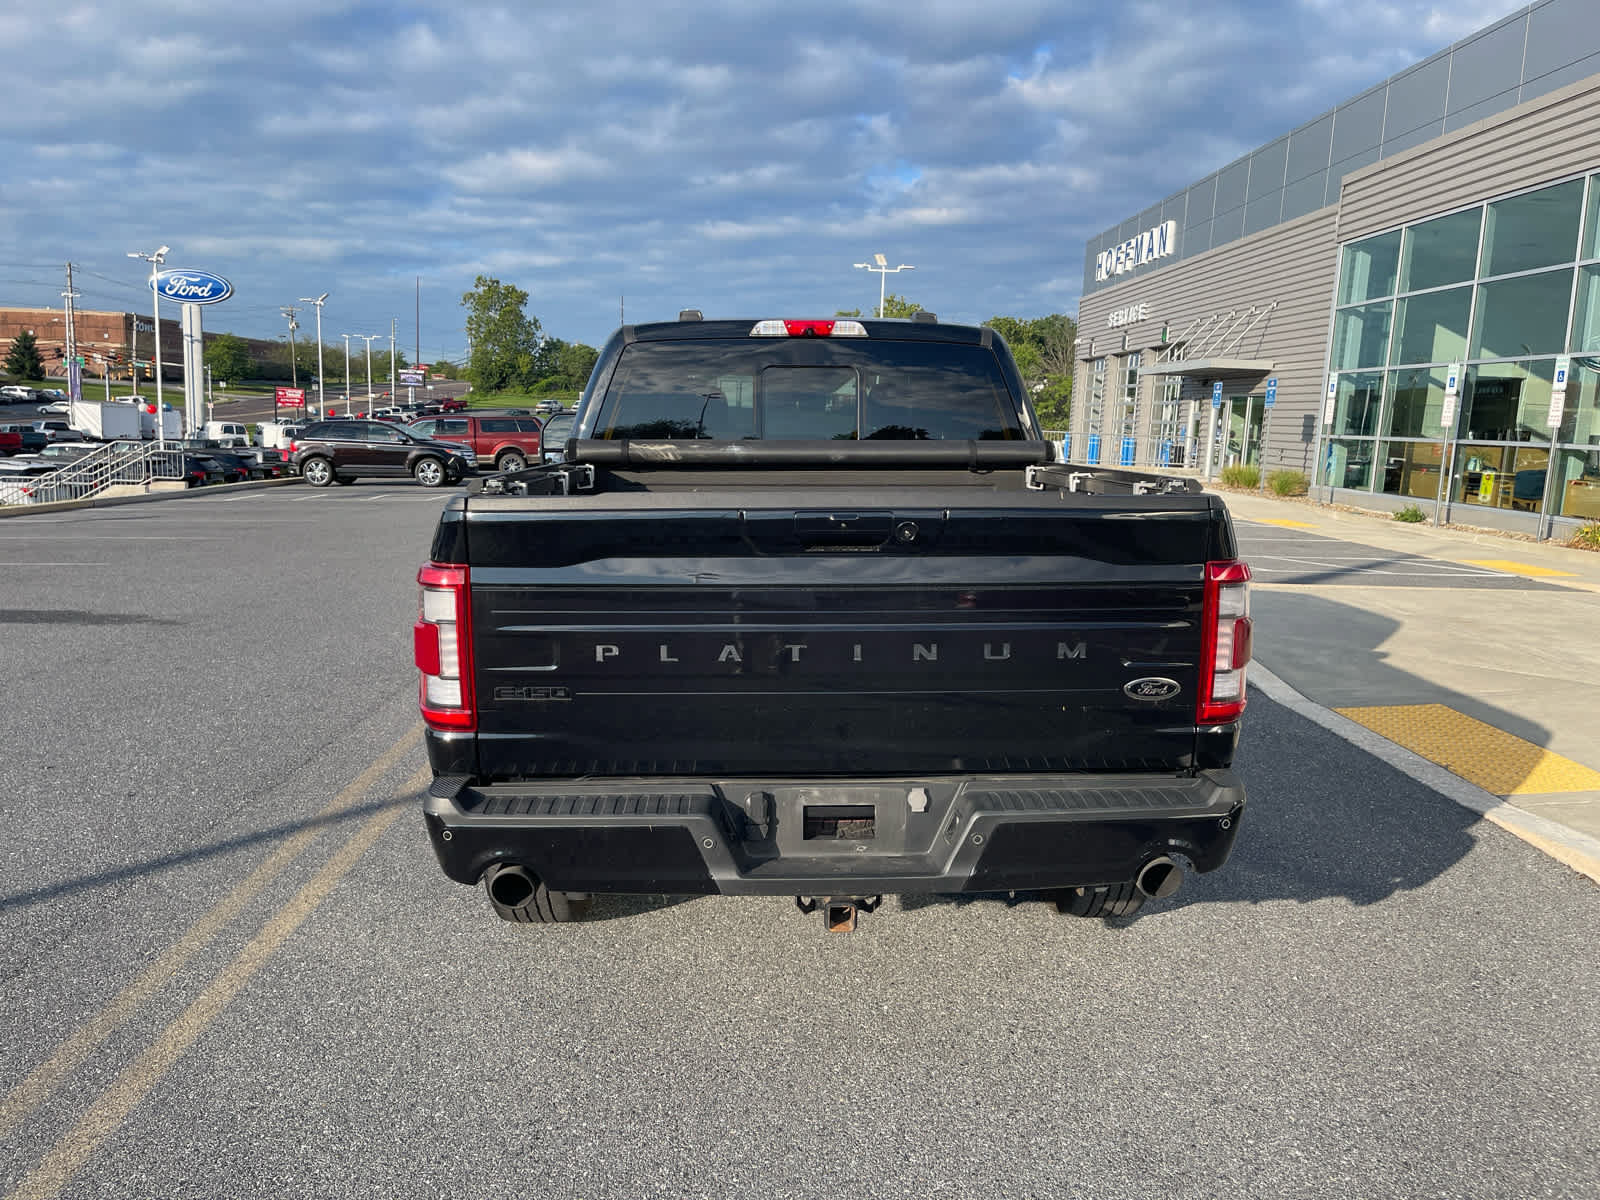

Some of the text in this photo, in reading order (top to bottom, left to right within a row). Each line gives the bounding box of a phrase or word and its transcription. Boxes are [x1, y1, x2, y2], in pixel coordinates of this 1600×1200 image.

[1096, 220, 1176, 281] HOFFMAN
[165, 276, 212, 296] Ford
[1109, 303, 1151, 328] SERVICE
[595, 643, 1088, 663] PLATINUM
